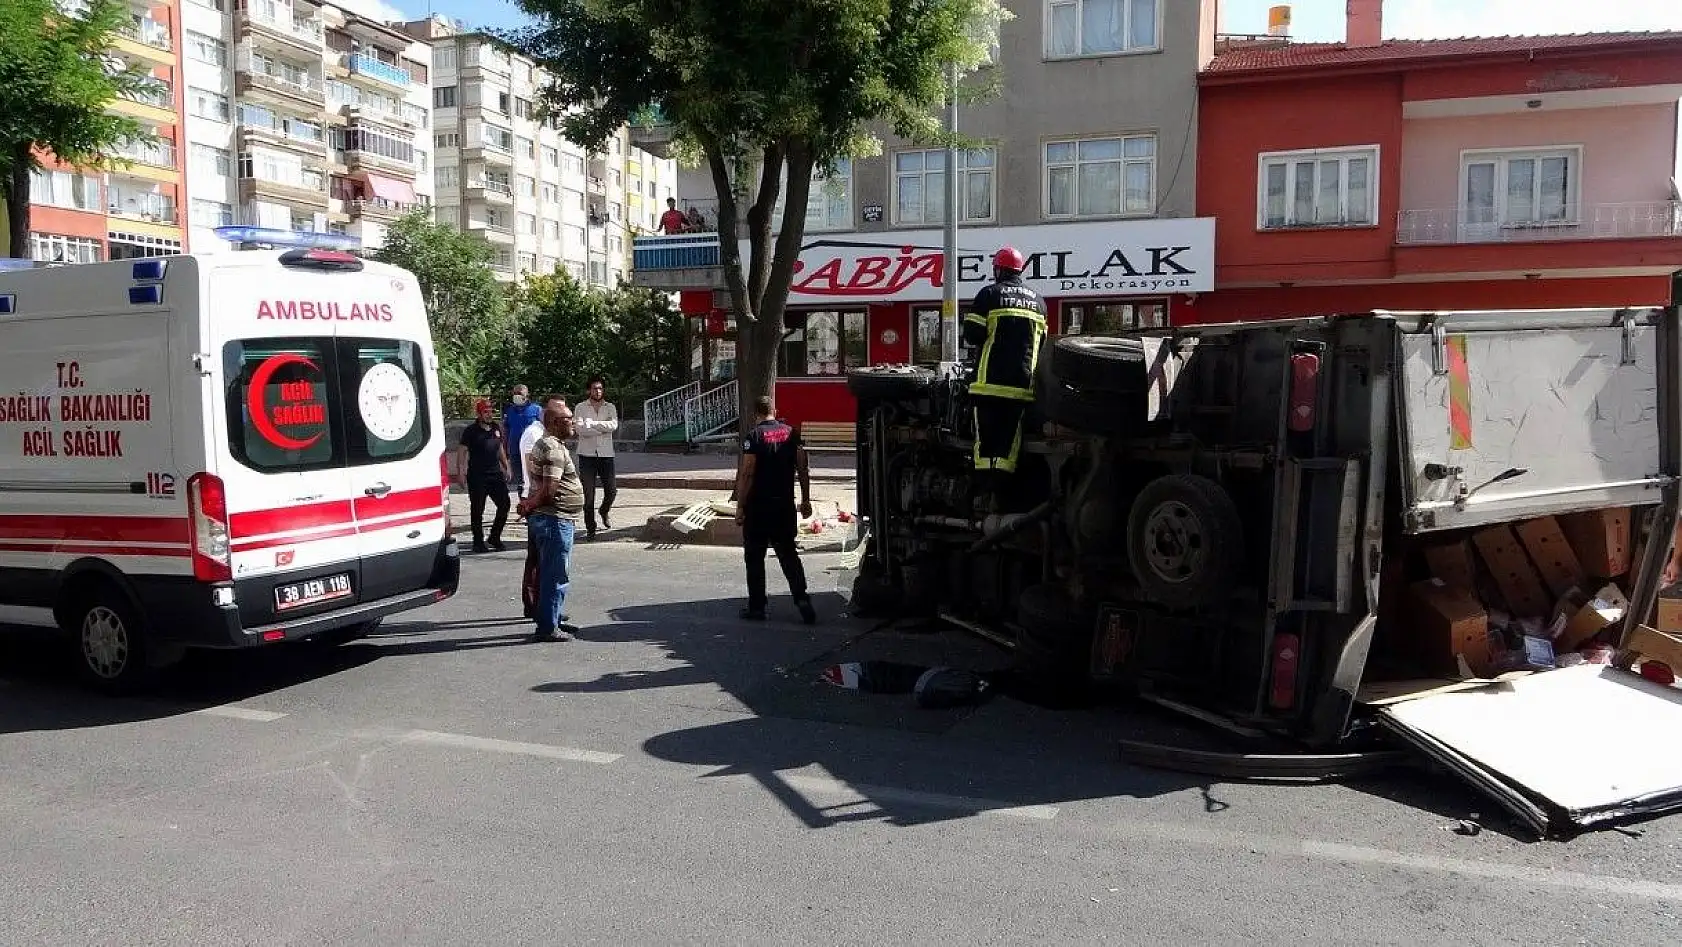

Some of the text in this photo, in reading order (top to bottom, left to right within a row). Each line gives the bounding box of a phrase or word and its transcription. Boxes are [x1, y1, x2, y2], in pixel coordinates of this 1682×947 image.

[1060, 279, 1192, 291] Dekorasyon
[257, 299, 394, 321] AMBULANS
[56, 361, 84, 388] T.C.
[0, 388, 150, 421] SAĞLIK BAKANLIĞI
[24, 425, 123, 457] ACİL SAĞLIK
[147, 472, 175, 494] 112
[284, 575, 348, 602] 38 AEN 118
